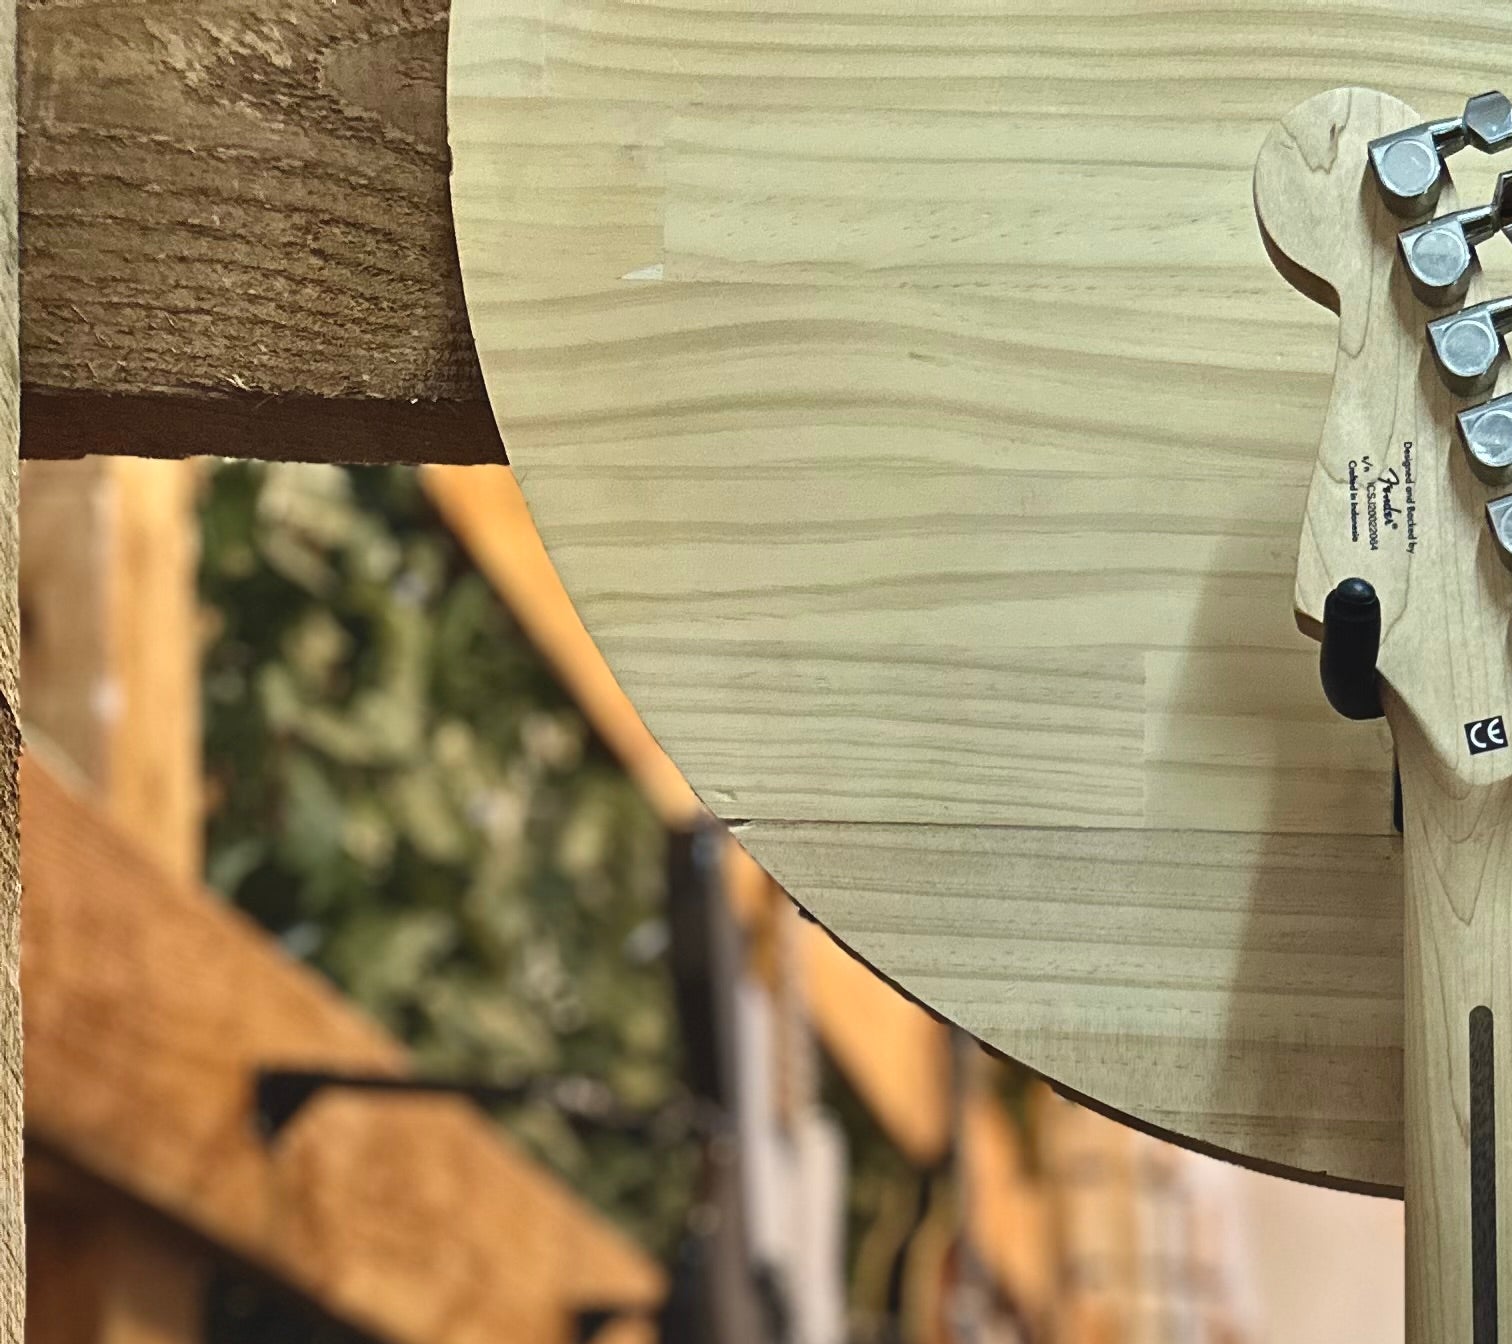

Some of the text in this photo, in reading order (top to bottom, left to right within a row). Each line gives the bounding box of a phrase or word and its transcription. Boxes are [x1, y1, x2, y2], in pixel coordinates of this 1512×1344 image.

[1350, 492, 1358, 501] in
[1402, 442, 1418, 554] Designed and Backed by
[1351, 502, 1360, 542] Indonesia
[1469, 718, 1504, 749] CE
